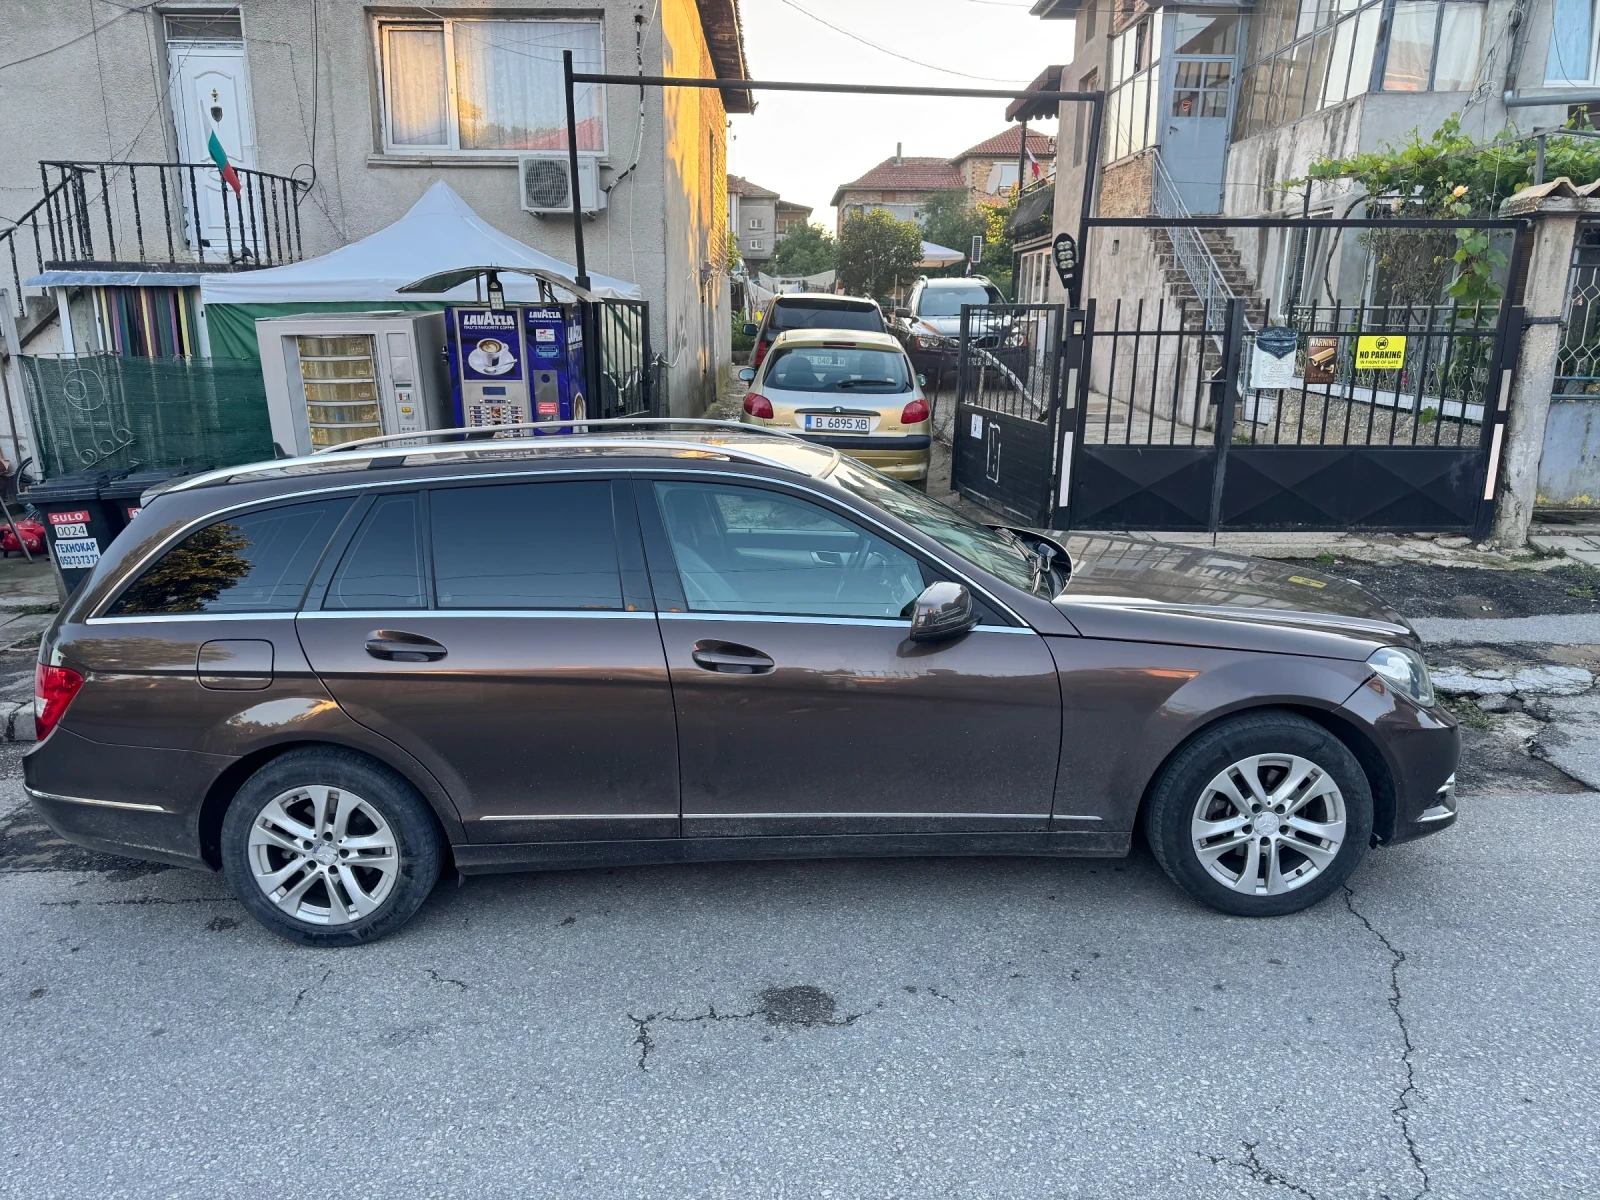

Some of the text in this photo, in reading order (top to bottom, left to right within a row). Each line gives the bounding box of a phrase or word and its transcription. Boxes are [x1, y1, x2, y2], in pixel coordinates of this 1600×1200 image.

[464, 311, 515, 326] LAVAZZA
[529, 309, 561, 319] LAVAZZA
[1310, 338, 1337, 347] WARNING
[1359, 350, 1402, 359] NO PARKING
[816, 417, 868, 430] B 6895 XB
[51, 512, 83, 522] SULO
[57, 525, 86, 537] 0024
[55, 541, 96, 554] ТЕХНОКАР
